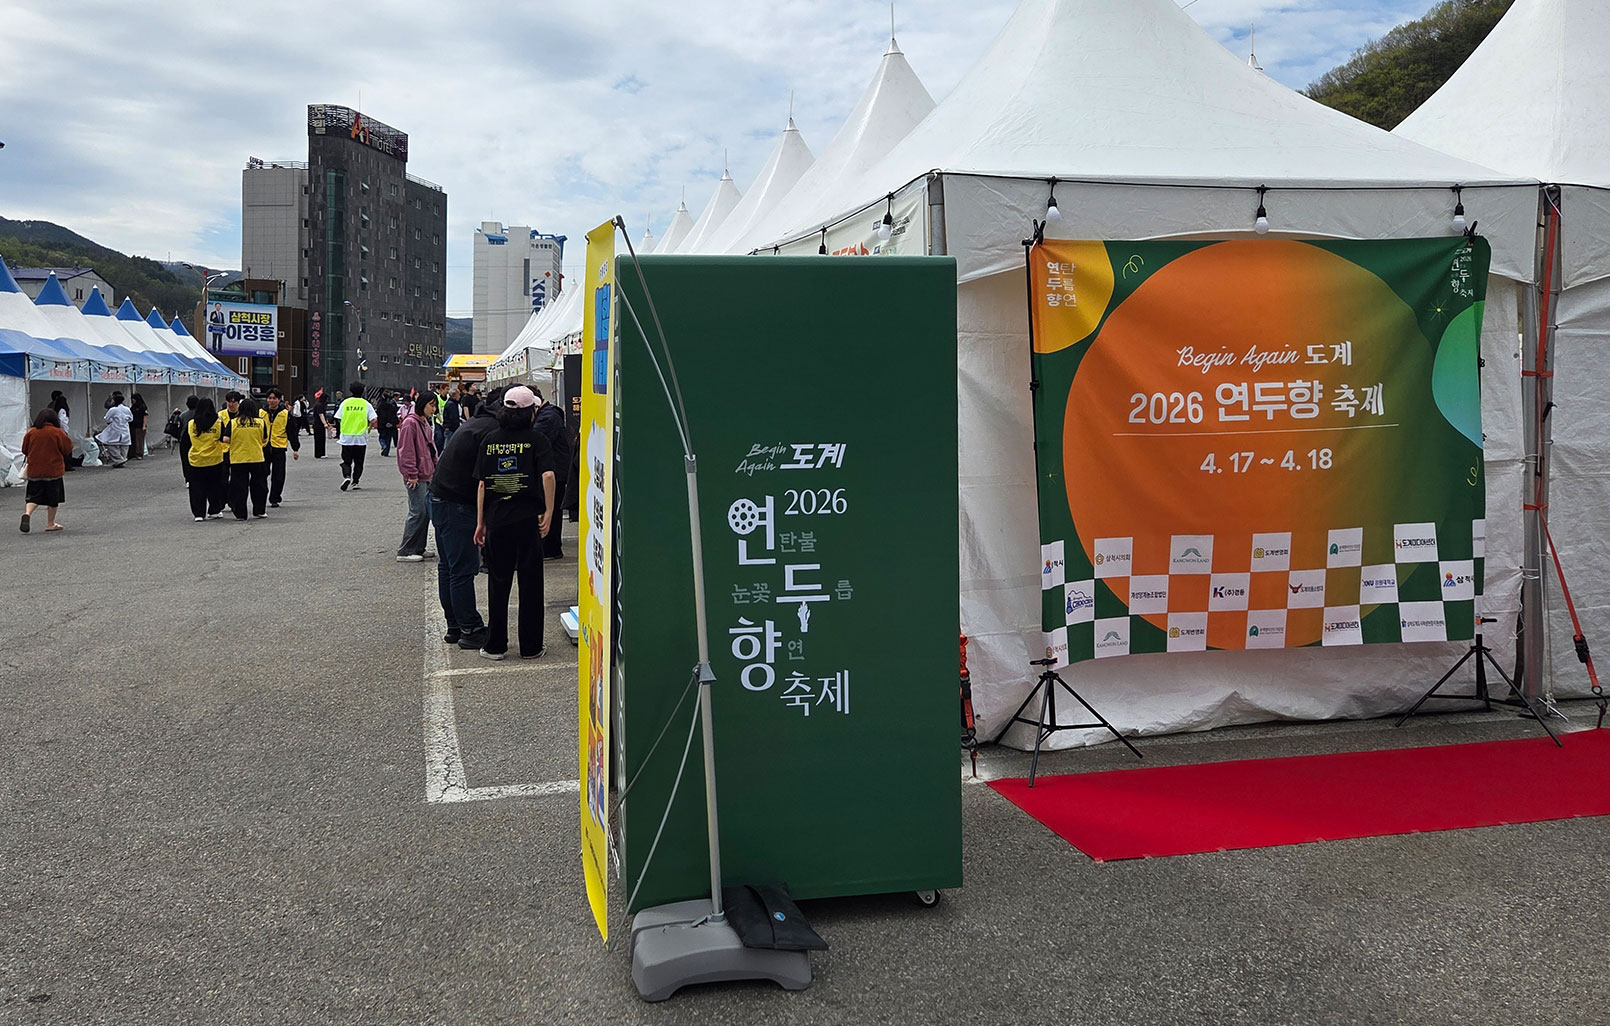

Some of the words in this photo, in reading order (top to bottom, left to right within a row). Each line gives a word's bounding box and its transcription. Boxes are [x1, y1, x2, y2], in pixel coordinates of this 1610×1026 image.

[231, 312, 271, 324] 삼척시장
[226, 325, 275, 342] 이정훈
[408, 343, 423, 359] 모텔
[1177, 345, 1237, 374] Begin
[1240, 344, 1300, 373] Again
[1304, 341, 1353, 367] 도계
[1128, 392, 1204, 425] 2026
[1215, 379, 1324, 422] 연두향
[1330, 382, 1385, 418] 축제
[746, 442, 787, 460] Begin
[779, 443, 847, 470] 도계
[735, 458, 777, 477] Again
[783, 488, 848, 515] 2026
[1105, 552, 1131, 563] 삼척시의회
[731, 582, 771, 604] 눈꽃
[729, 616, 782, 691] 향
[787, 639, 805, 661] 연
[780, 669, 850, 717] 축제
